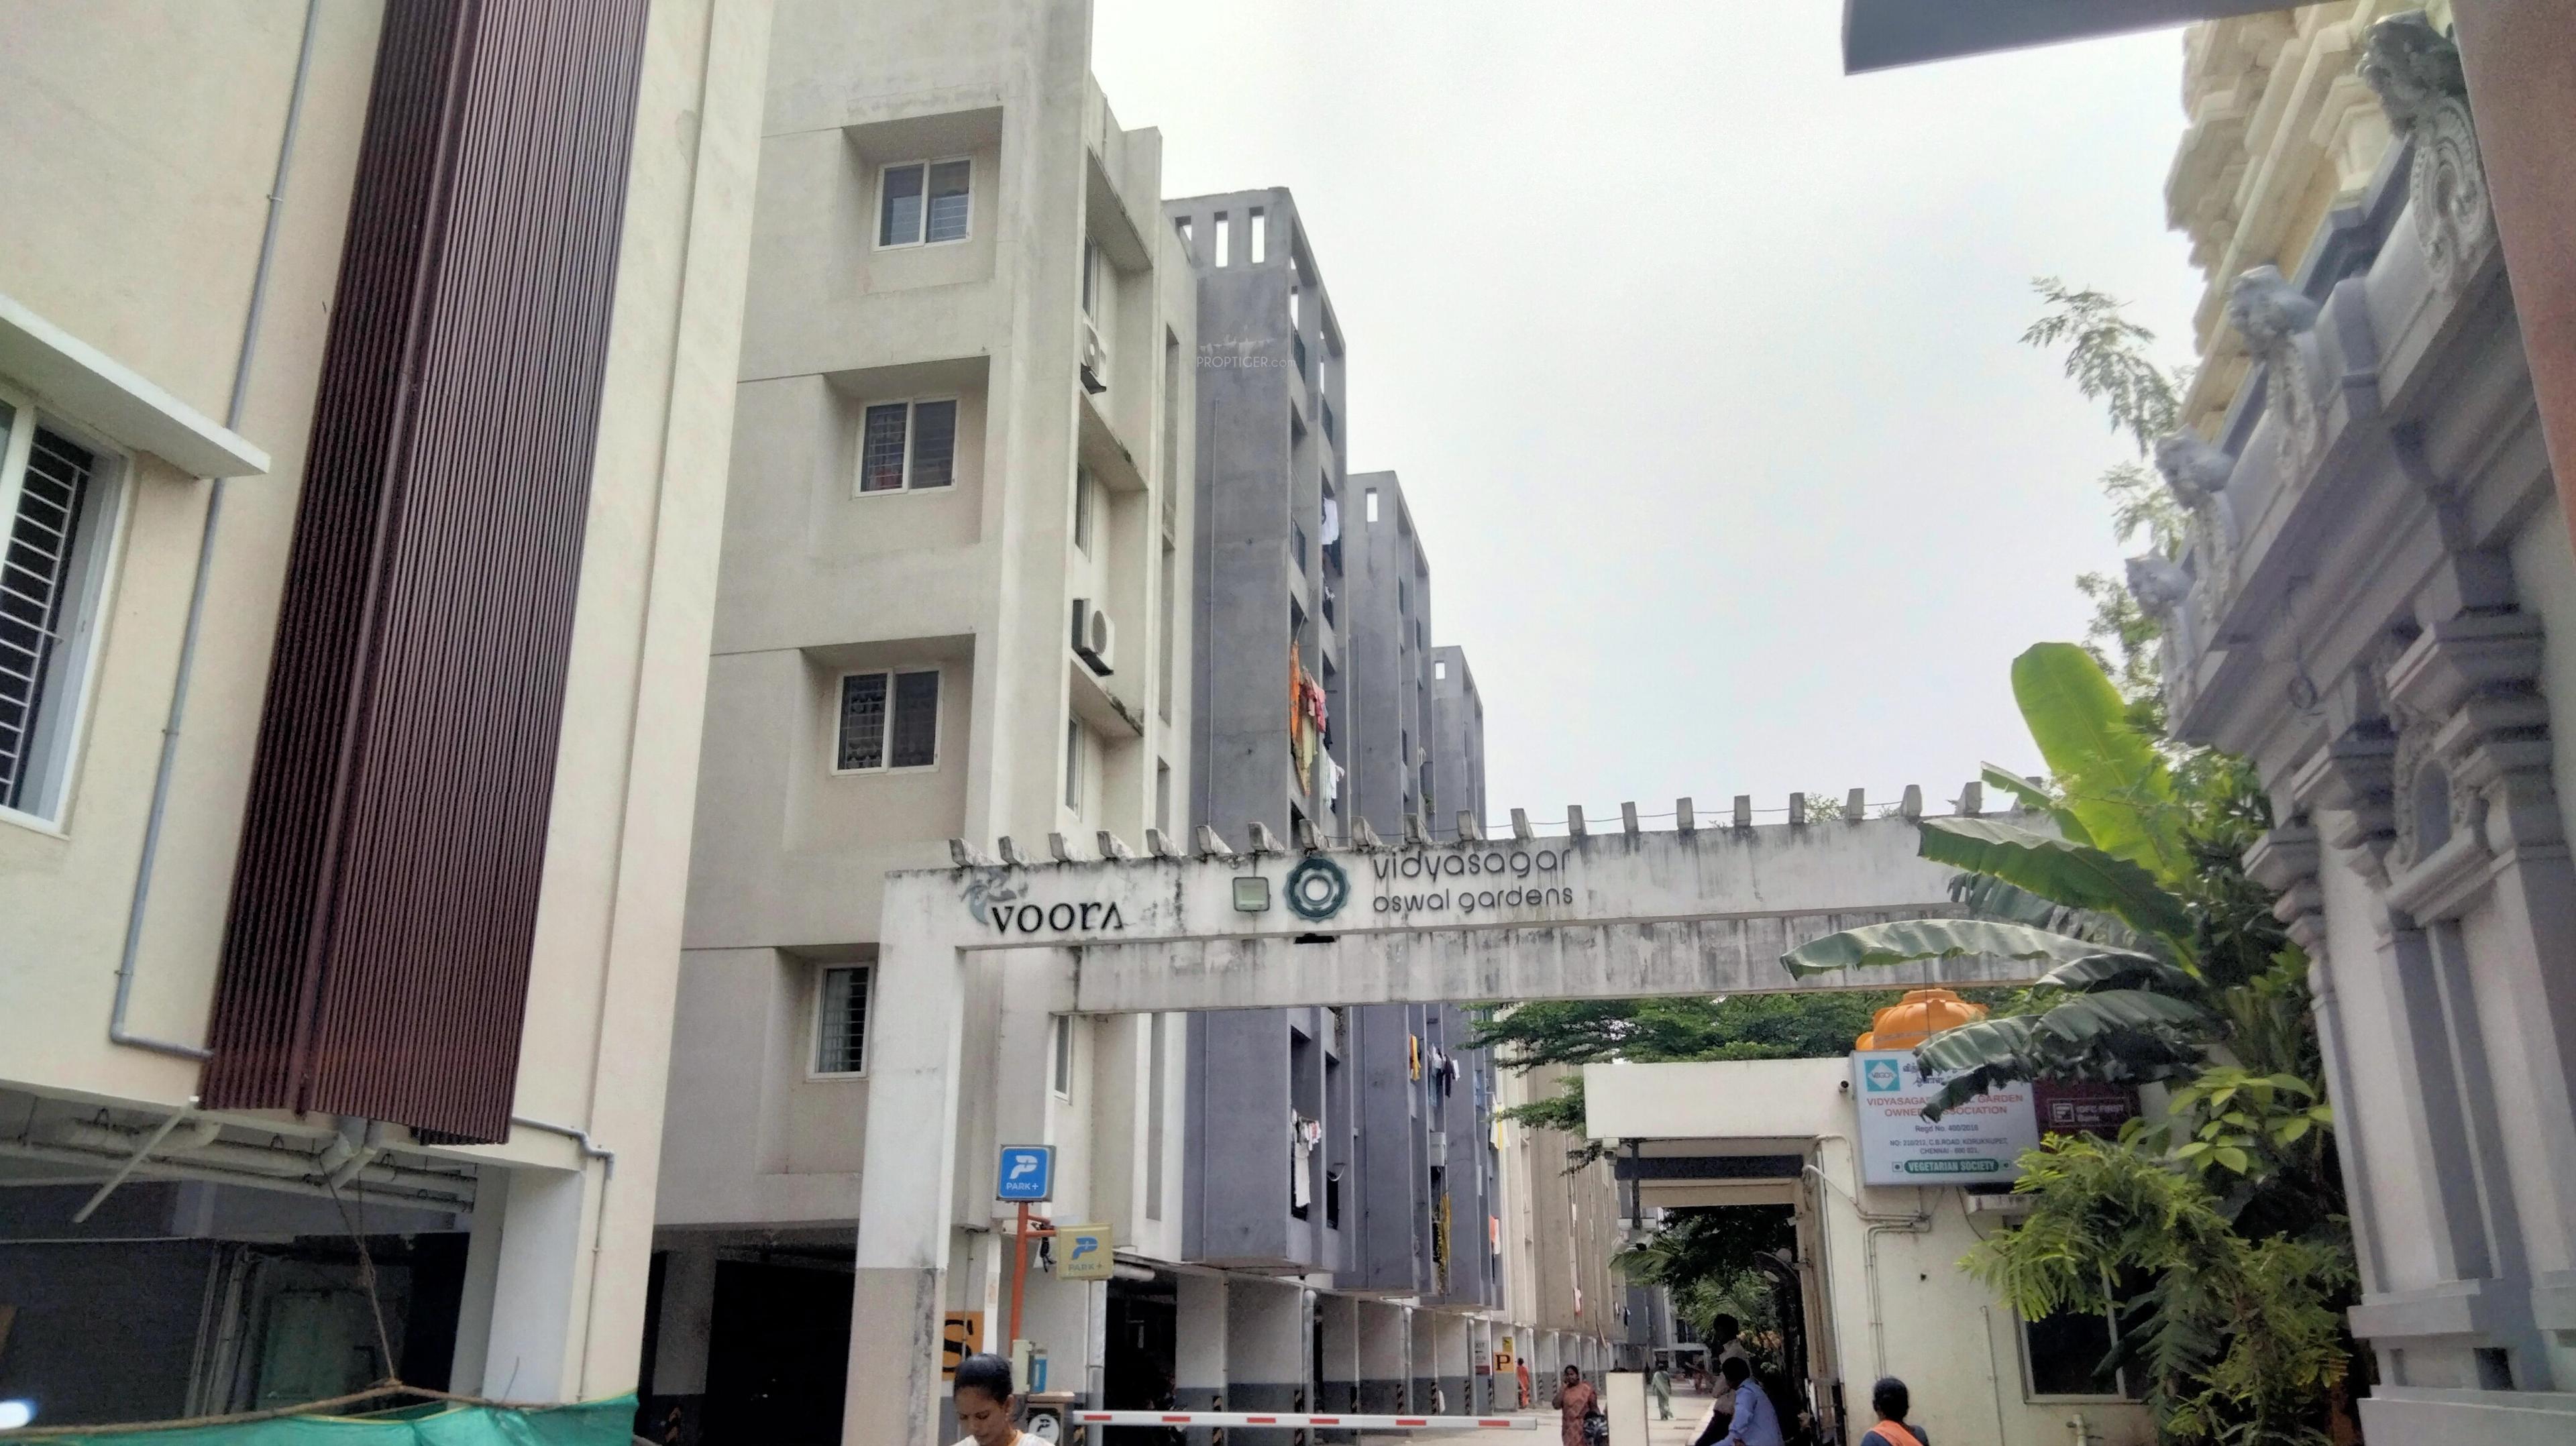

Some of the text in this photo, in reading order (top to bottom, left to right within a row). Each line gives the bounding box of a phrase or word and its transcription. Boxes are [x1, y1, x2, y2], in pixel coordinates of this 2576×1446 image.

[1374, 842, 1570, 883] vidyasagar
[1373, 885, 1573, 913] oswal gardens
[1867, 1097, 1930, 1105] VIDYASAGA
[1978, 1094, 2023, 1103] GARDEN
[1915, 1125, 1933, 1133] Regd
[1908, 1160, 1996, 1171] VEGETARIAN SOCIETY
[1495, 1355, 1511, 1371] P
